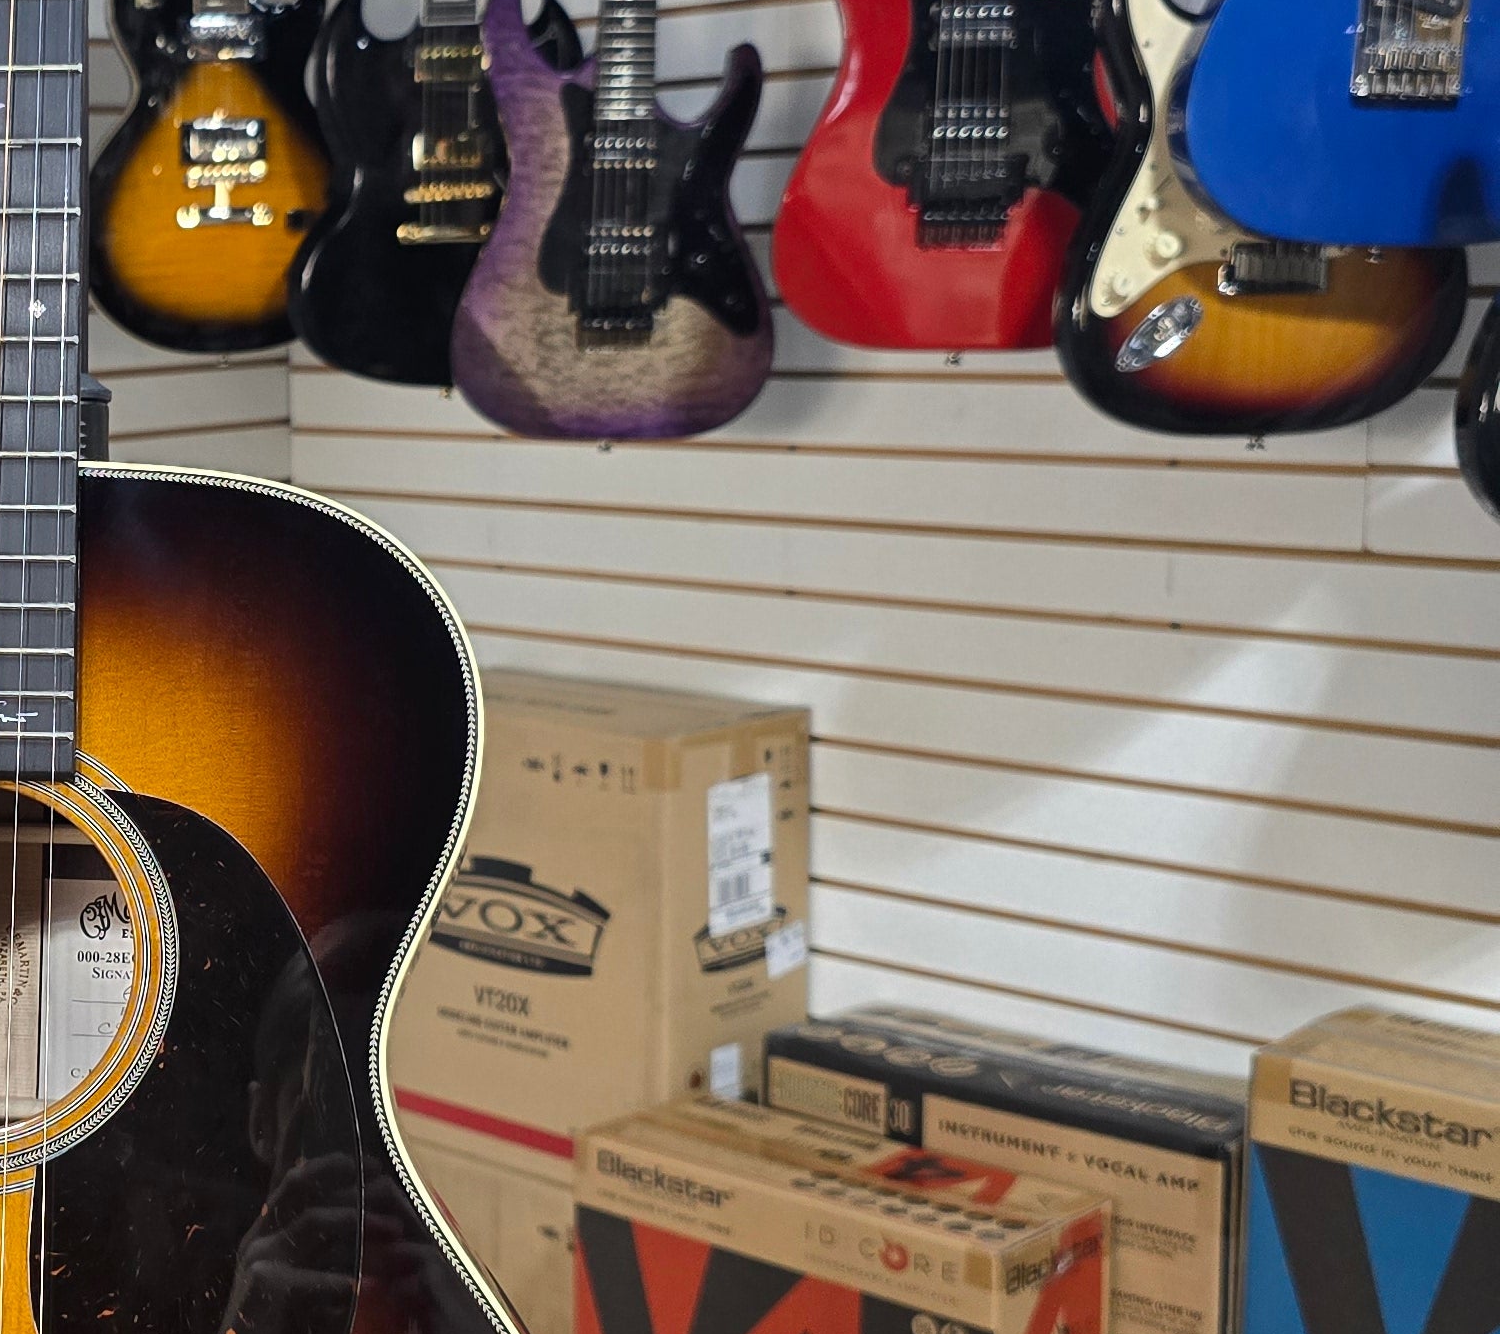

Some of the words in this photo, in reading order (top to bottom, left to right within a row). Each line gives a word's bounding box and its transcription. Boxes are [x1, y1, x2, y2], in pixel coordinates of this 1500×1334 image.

[474, 985, 530, 1016] VT20X
[890, 1098, 913, 1135] 30
[1289, 1078, 1494, 1149] Blackstar
[597, 1148, 724, 1209] Blackstar
[937, 1118, 1061, 1159] INSTRUMENT
[1083, 1153, 1152, 1184] VOCAL
[1155, 1171, 1200, 1193] AMP
